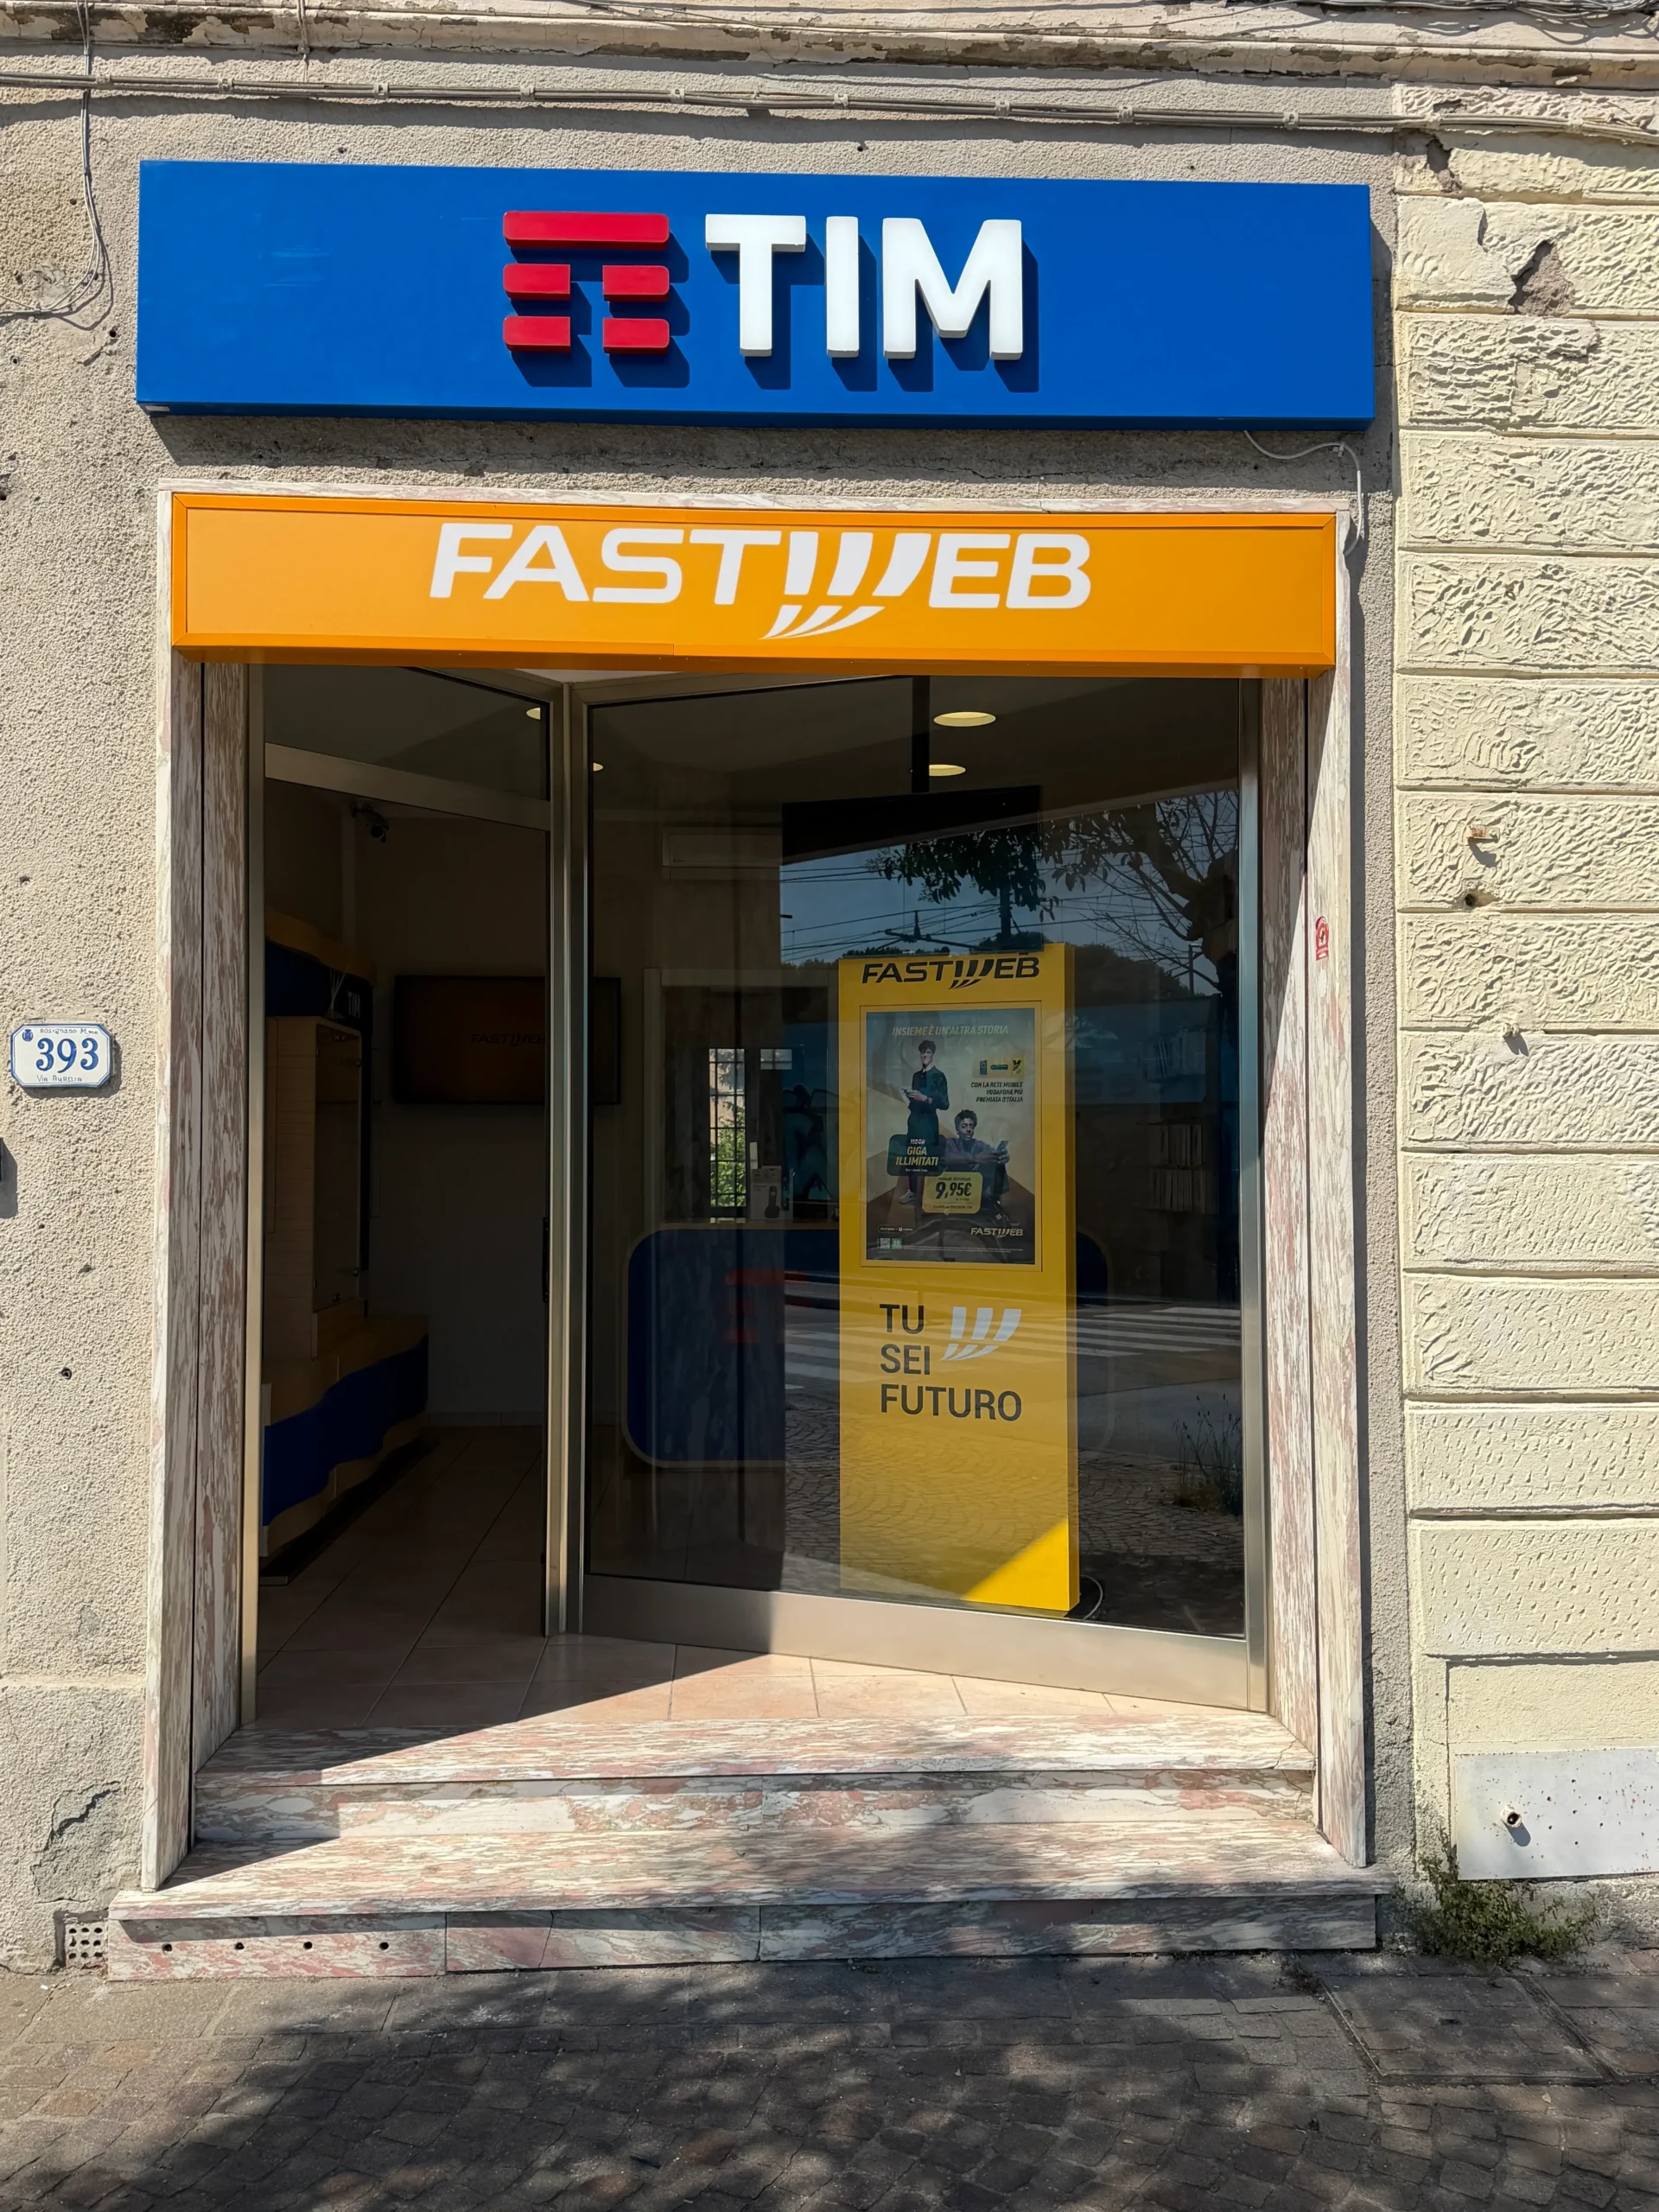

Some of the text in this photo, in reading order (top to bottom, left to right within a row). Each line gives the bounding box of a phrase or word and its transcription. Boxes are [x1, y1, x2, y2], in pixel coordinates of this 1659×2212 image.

[705, 213, 1023, 361] TIM
[429, 522, 1092, 640] FASTWEB
[861, 957, 1040, 989] FASTWEB
[893, 1024, 1009, 1036] INSIEME È UN'ALTRA STORIA
[35, 1038, 99, 1073] 393
[895, 1156, 939, 1166] ILLIMITATI
[906, 1146, 927, 1156] GIGA
[936, 1181, 972, 1199] 9,95€
[970, 1227, 1024, 1238] FASTWEB
[880, 1303, 925, 1334] TU
[880, 1344, 931, 1375] SEI
[880, 1383, 1022, 1421] FUTURO
